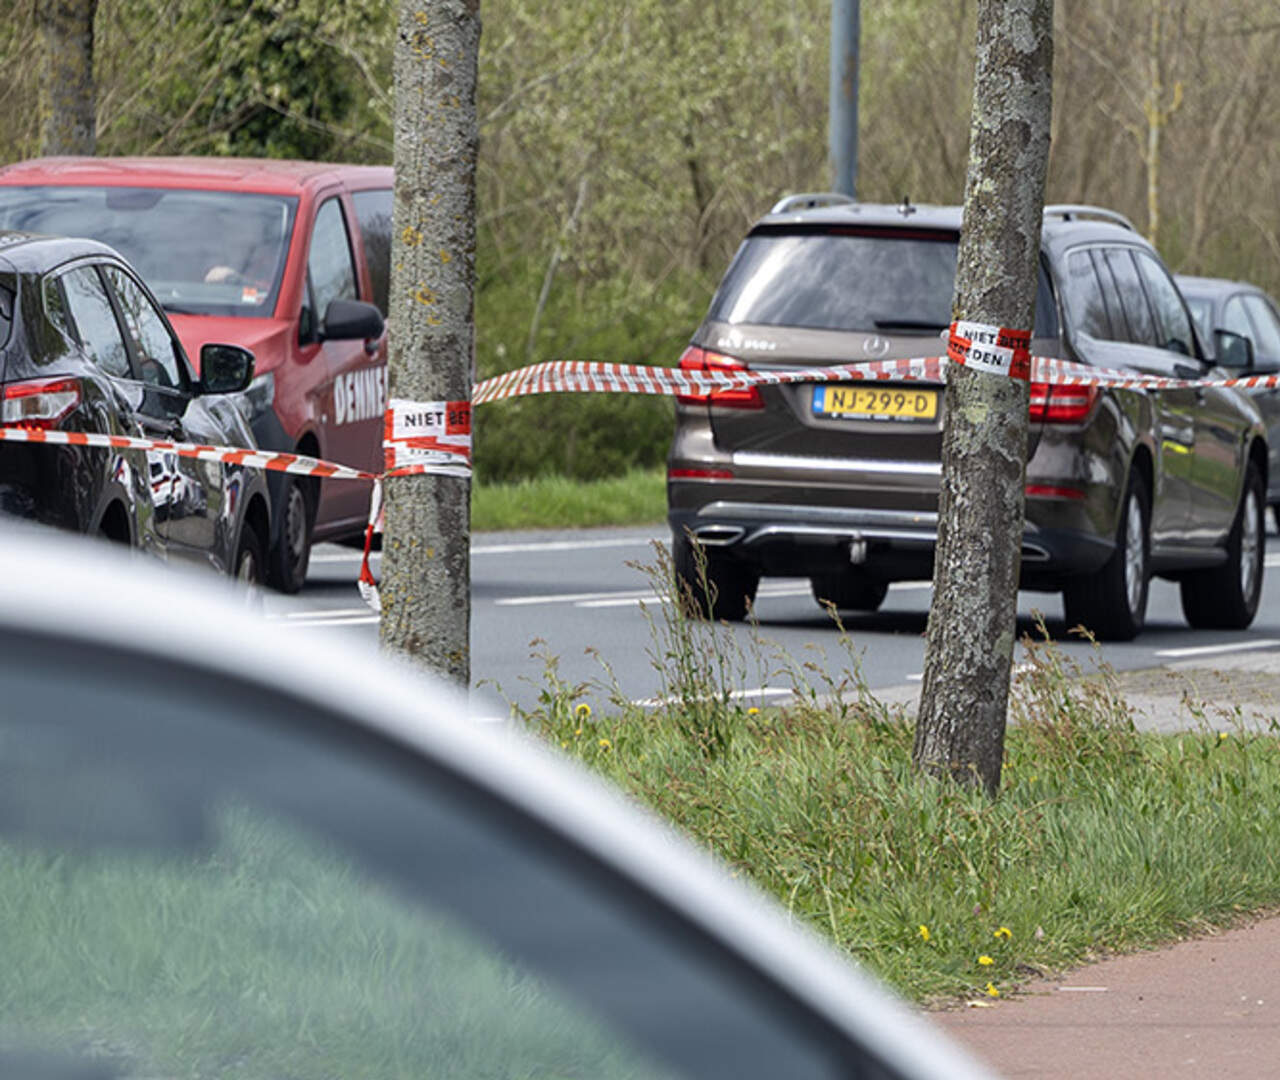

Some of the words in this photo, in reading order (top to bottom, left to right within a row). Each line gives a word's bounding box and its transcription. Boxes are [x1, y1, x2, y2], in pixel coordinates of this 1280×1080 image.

[963, 329, 996, 345] NIET
[831, 390, 929, 413] NJ-299-D
[404, 411, 445, 427] NIET
